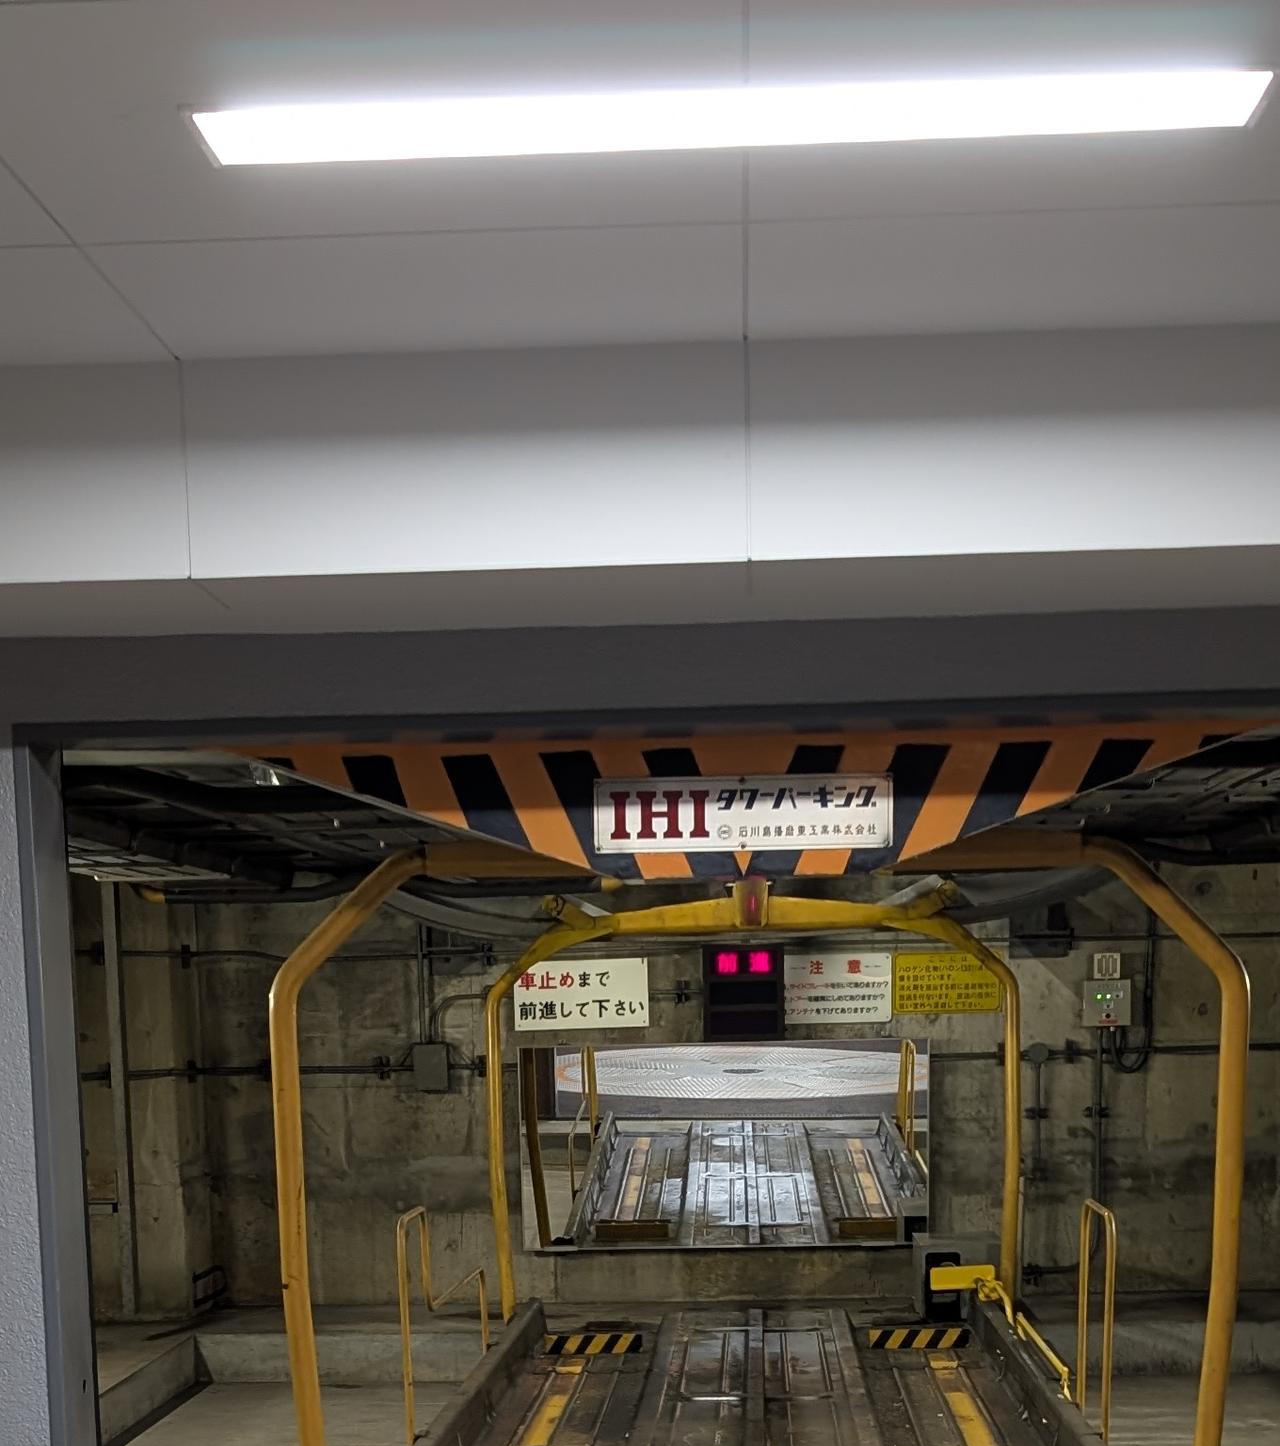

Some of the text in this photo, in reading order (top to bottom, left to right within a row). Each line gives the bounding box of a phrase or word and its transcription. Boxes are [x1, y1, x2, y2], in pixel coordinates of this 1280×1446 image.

[716, 785, 877, 811] タワーパーキング
[609, 789, 710, 840] IHI
[738, 823, 878, 838] 石川島播磨重工業株式会社
[717, 951, 770, 975] 前進
[518, 970, 610, 990] 車止めまで
[518, 998, 645, 1020] 前進して下さい
